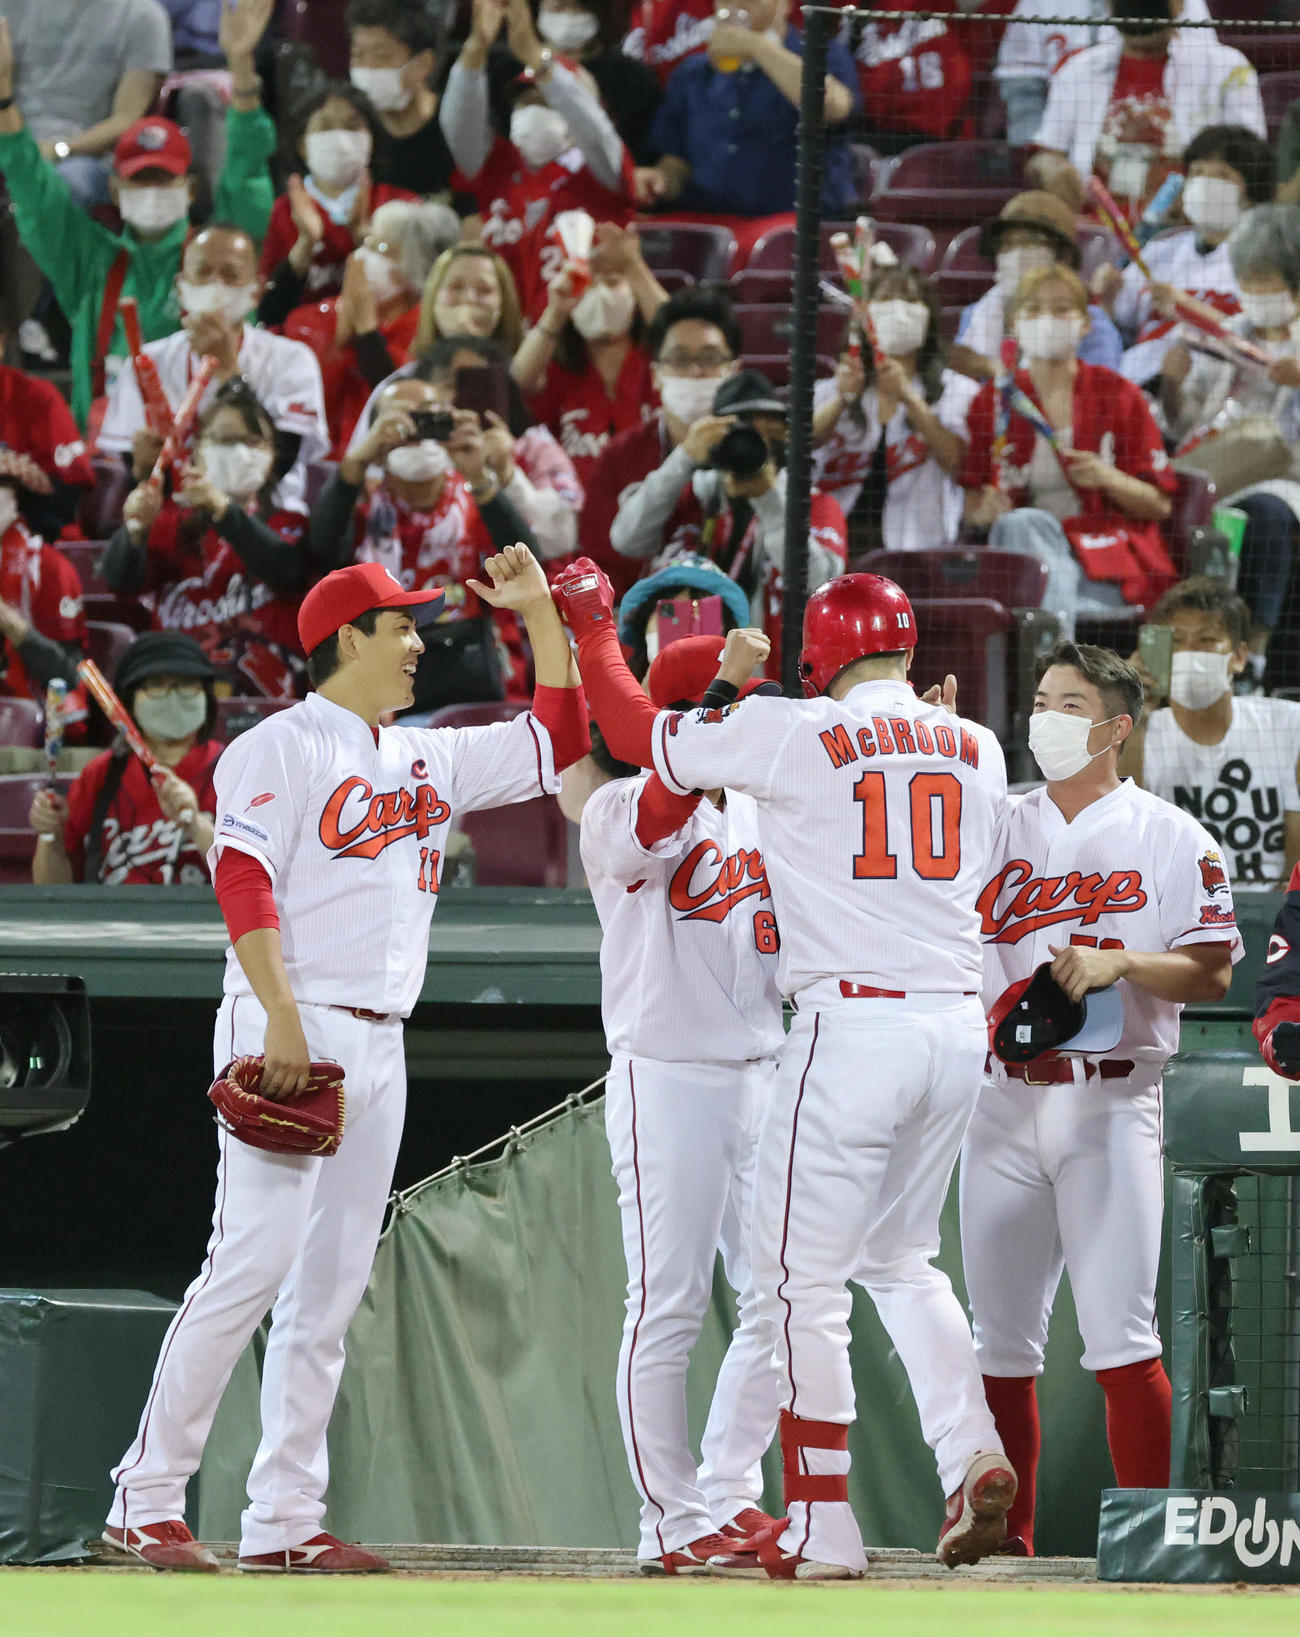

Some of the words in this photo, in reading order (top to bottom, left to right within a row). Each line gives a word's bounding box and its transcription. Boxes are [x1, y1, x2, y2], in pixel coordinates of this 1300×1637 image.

[896, 612, 910, 629] 10
[818, 716, 980, 770] McBROOM
[319, 775, 451, 860] Carp
[852, 771, 963, 881] 10
[417, 846, 441, 895] 11
[974, 858, 1148, 946] Carp
